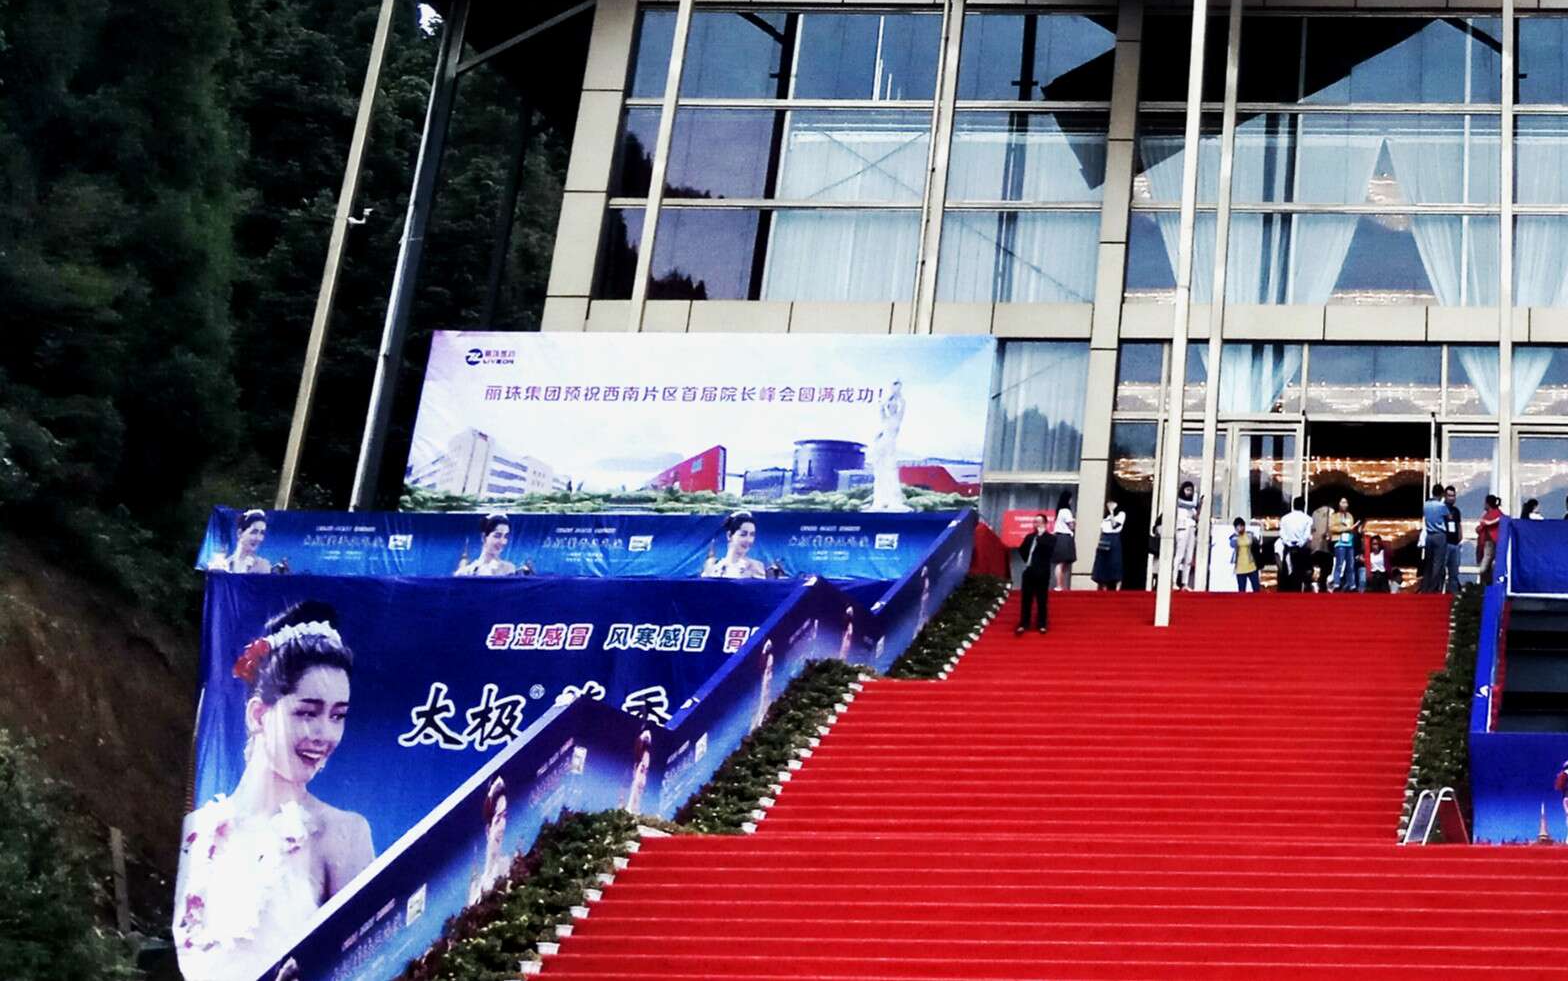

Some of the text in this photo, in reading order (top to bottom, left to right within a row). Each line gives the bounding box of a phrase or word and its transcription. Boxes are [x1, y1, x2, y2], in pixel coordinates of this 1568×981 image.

[486, 623, 594, 650] 暑湿感冒
[603, 623, 711, 652] 风寒感冒
